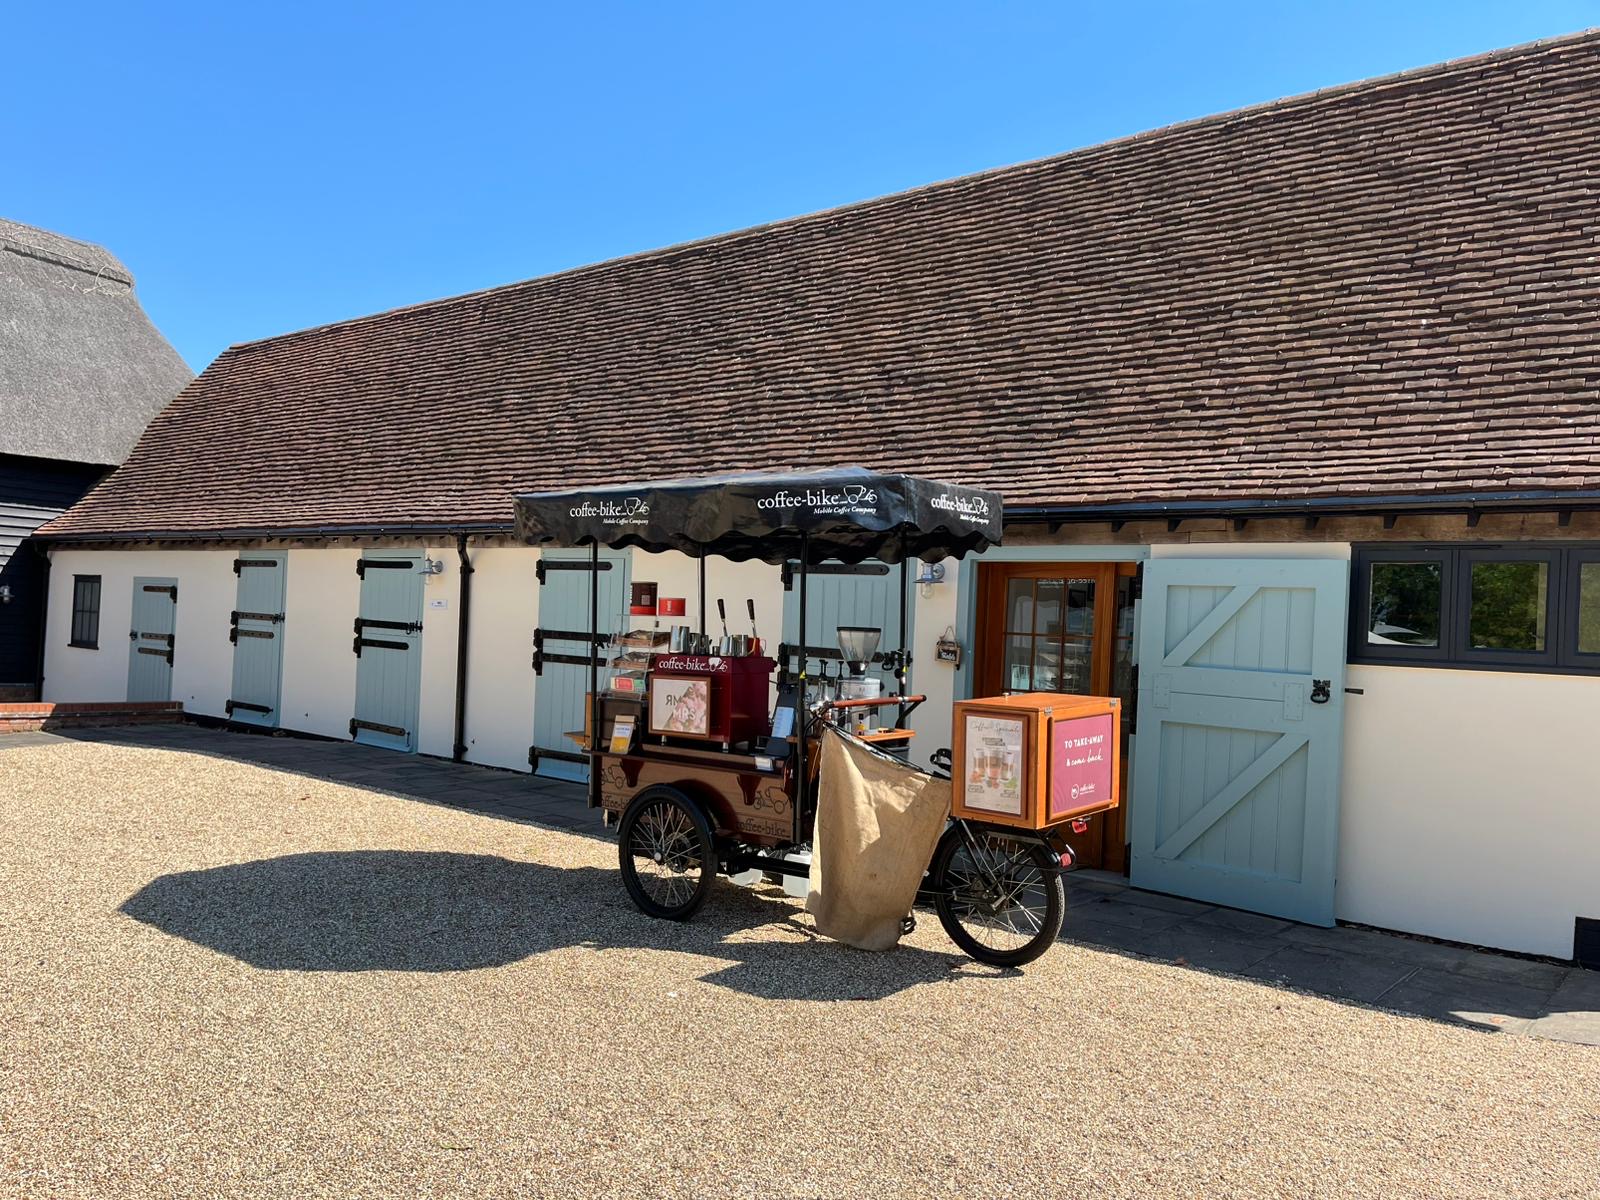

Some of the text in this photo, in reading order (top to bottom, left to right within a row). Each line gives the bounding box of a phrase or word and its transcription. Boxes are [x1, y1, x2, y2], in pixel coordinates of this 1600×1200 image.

[757, 489, 838, 509] coffee-bike
[931, 494, 973, 512] coffee-bike
[569, 501, 621, 517] coffee-bike
[833, 506, 850, 515] Coffee
[851, 505, 877, 514] Company
[659, 657, 704, 671] coffee-bike
[673, 707, 696, 720] MRS
[1064, 740, 1073, 749] TO
[1071, 757, 1086, 766] come
